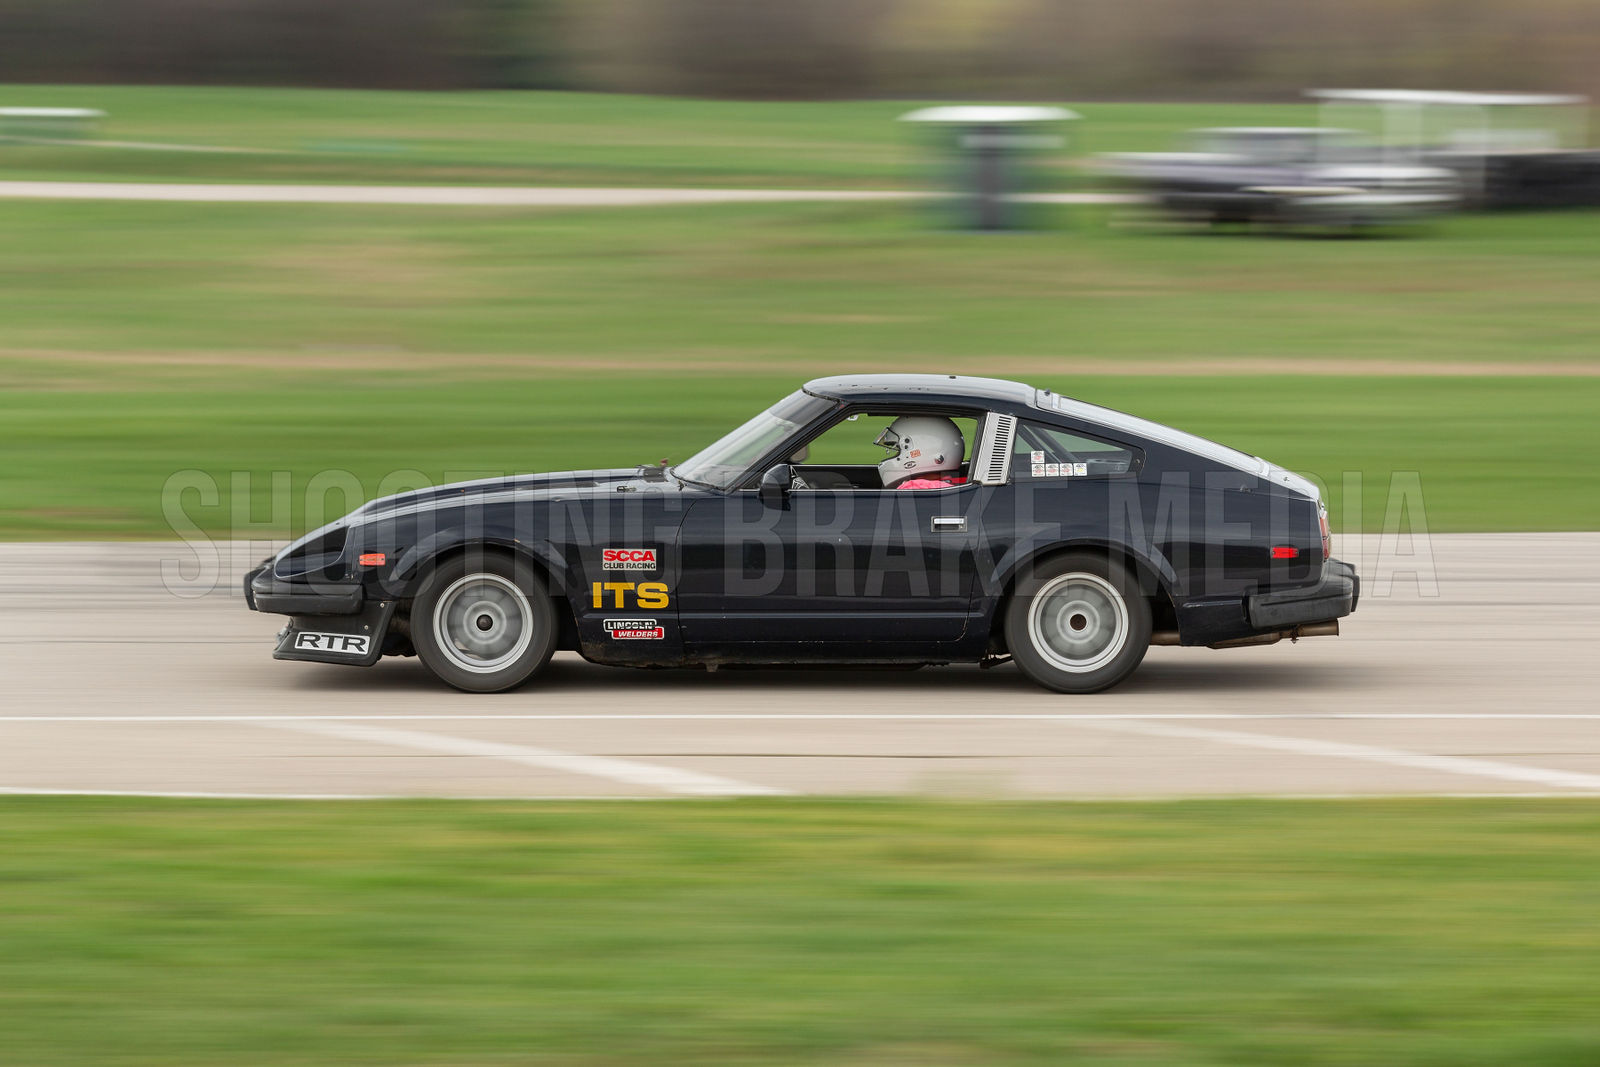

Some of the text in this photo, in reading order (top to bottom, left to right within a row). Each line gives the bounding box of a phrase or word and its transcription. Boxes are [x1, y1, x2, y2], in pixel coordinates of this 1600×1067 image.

[603, 550, 656, 562] SCCA
[592, 582, 670, 609] ITS
[607, 621, 653, 630] LINCOLN
[618, 631, 659, 639] WELDERS
[296, 633, 367, 653] RTR
